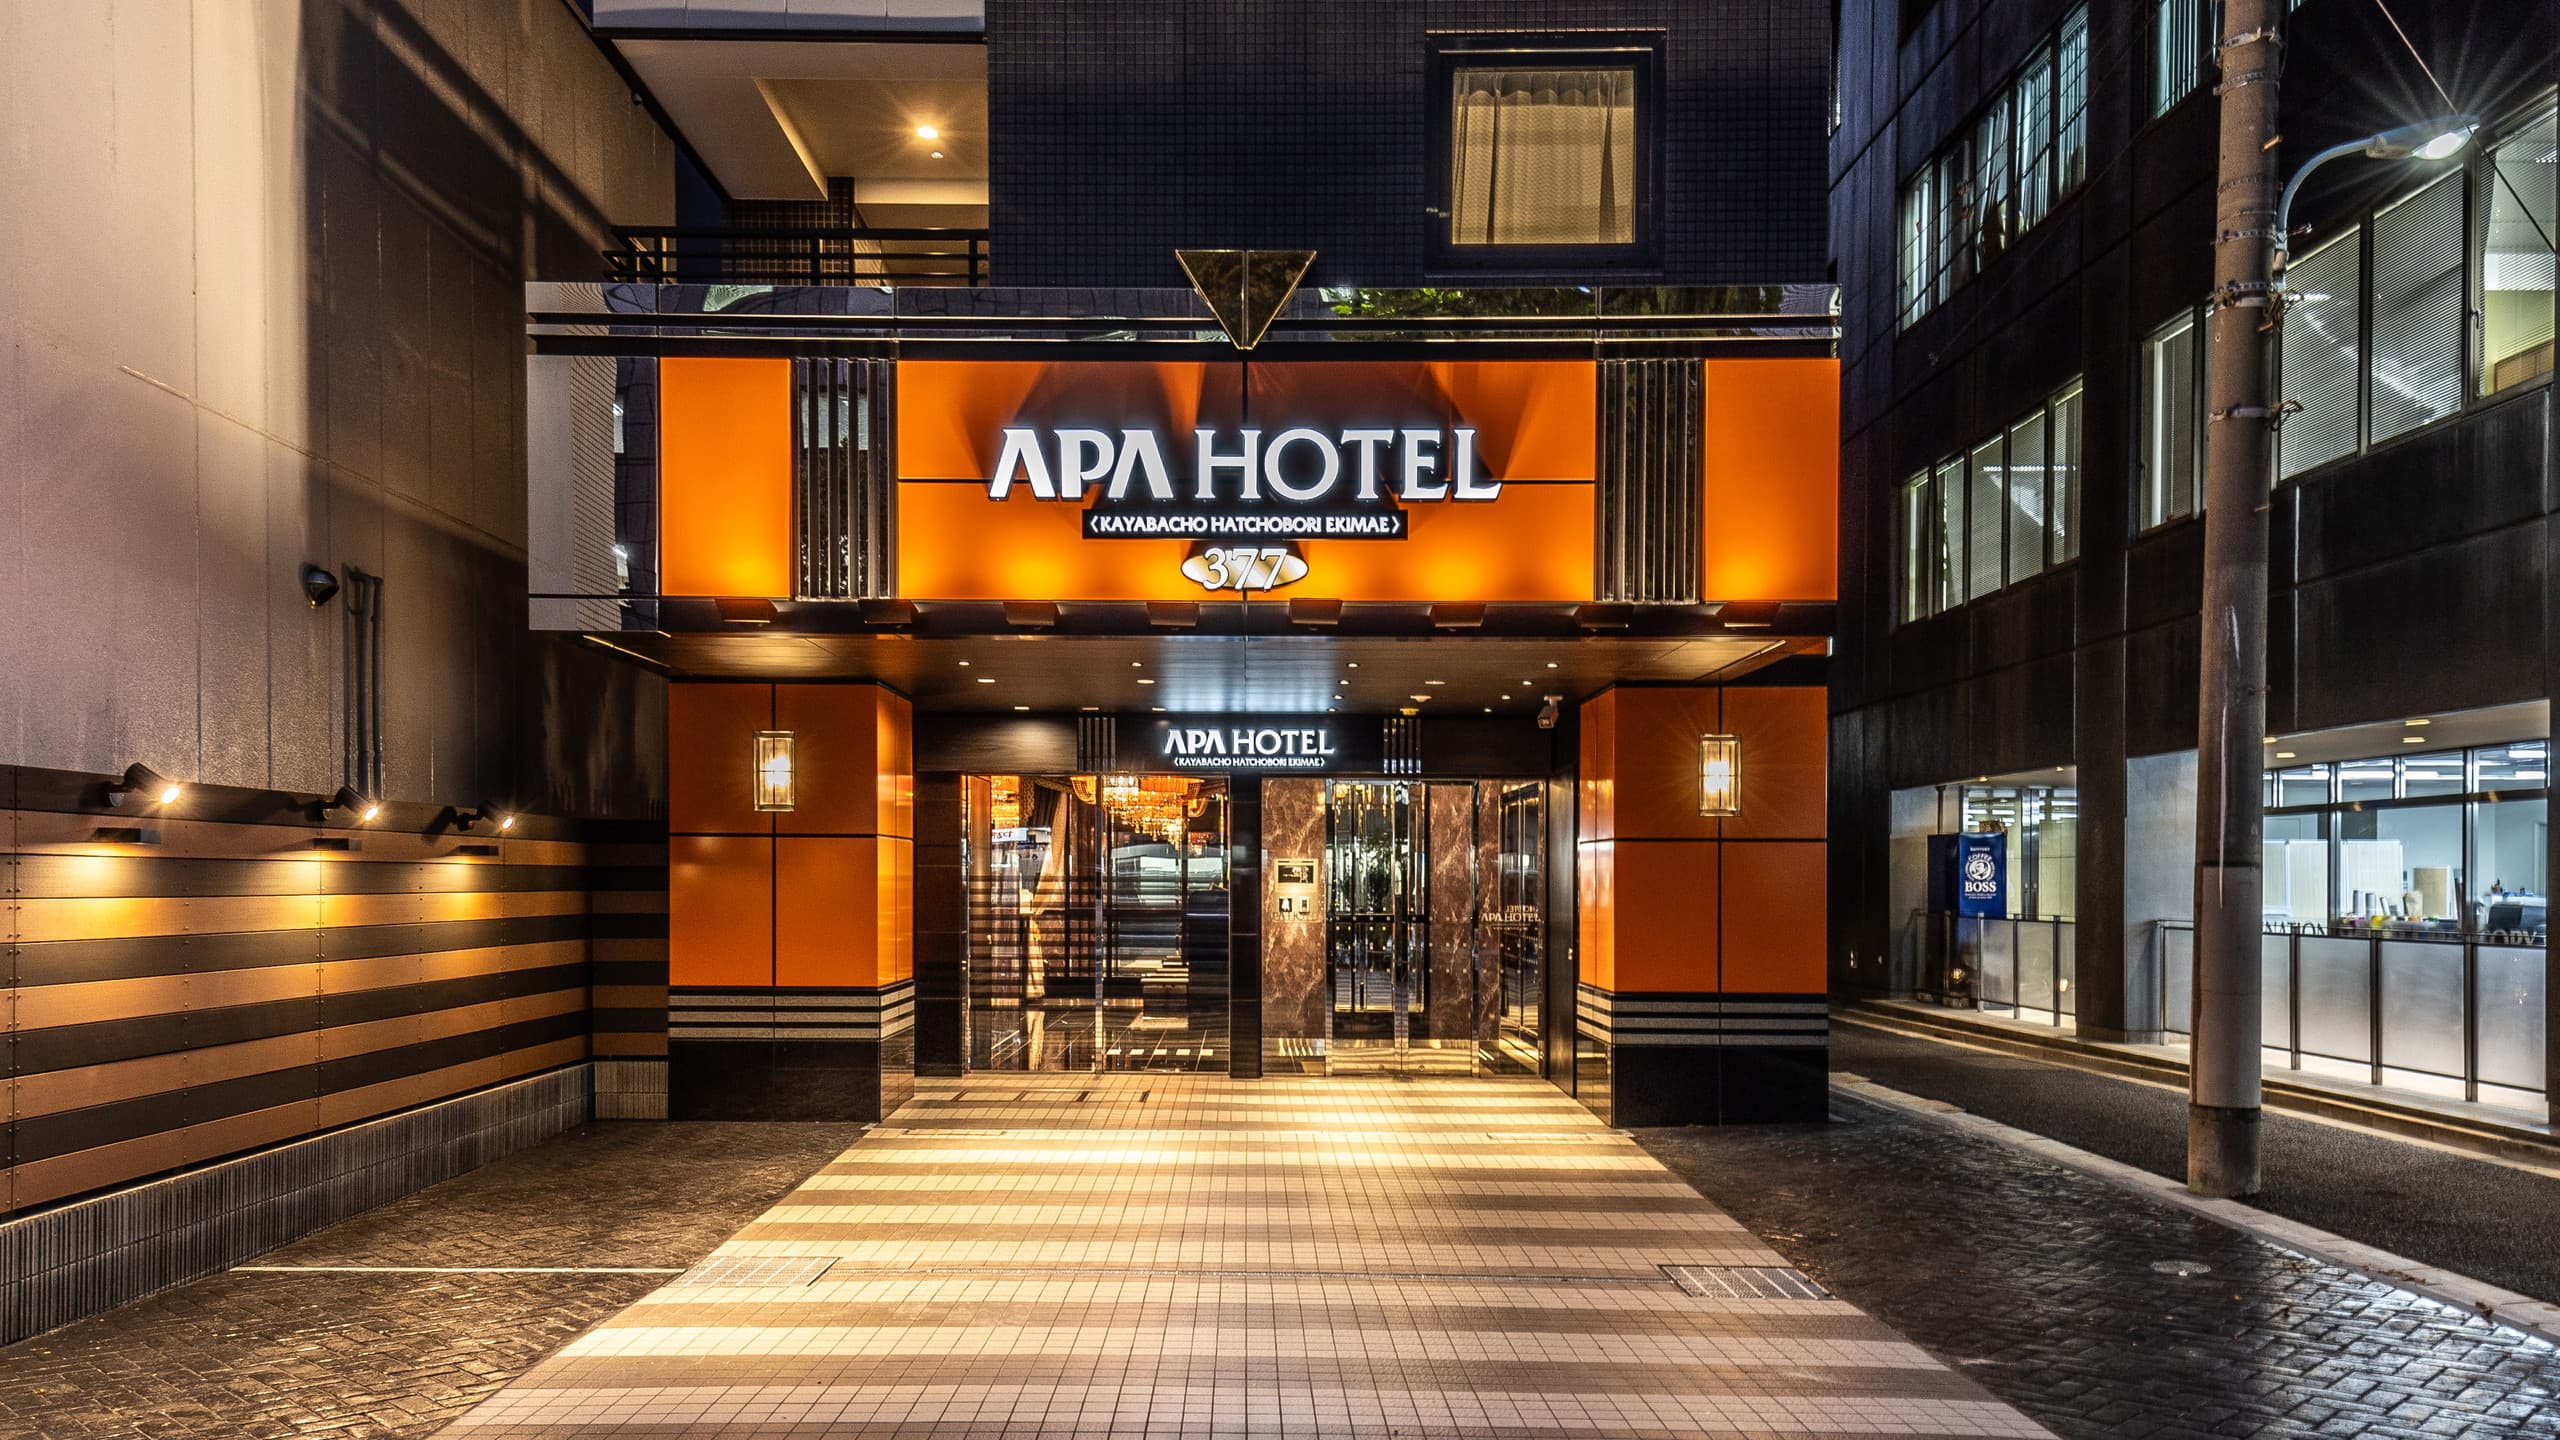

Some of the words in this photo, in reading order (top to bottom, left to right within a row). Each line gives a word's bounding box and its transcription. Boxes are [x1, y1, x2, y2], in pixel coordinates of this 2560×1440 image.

[988, 427, 1175, 500] APA
[1193, 427, 1503, 501] HOTEL
[1210, 516, 1322, 533] HATCHOBORI
[1201, 546, 1288, 592] 377
[1164, 729, 1226, 754] APA
[1232, 729, 1335, 754] HOTEL
[1233, 757, 1288, 767] HATCHOBORI
[1965, 881, 1997, 892] BOSS
[1481, 912, 1502, 921] APA
[1504, 912, 1541, 921] HOTEL
